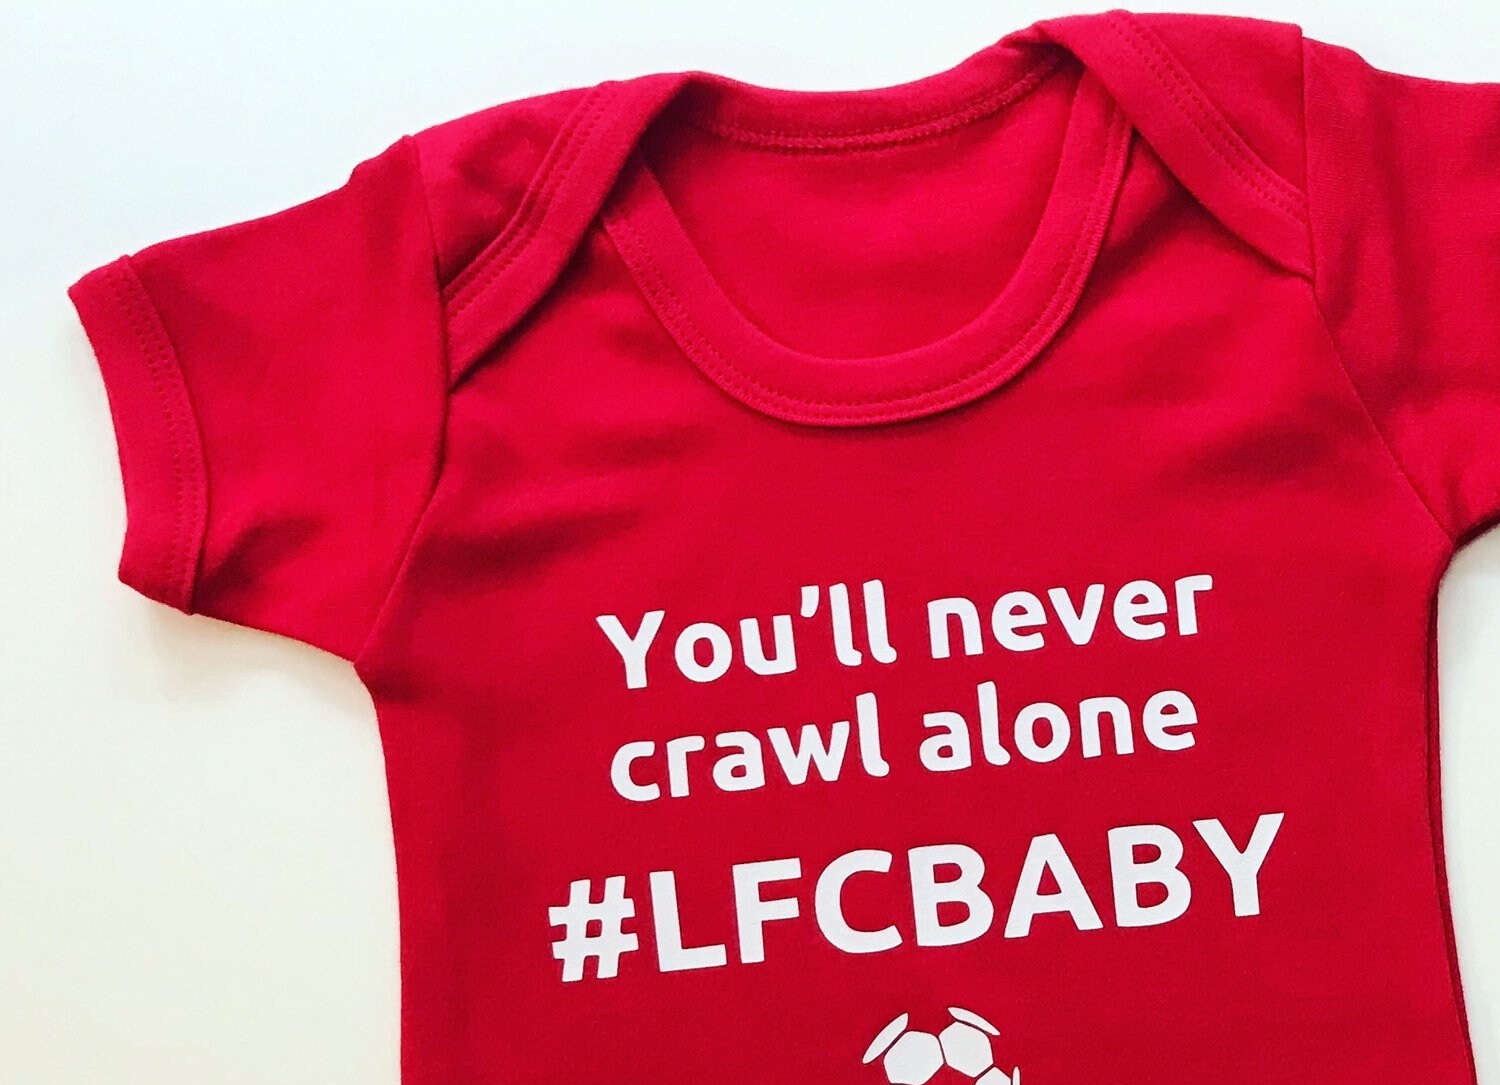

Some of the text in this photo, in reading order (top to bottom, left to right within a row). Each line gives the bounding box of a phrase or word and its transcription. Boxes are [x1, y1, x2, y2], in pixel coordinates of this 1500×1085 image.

[595, 574, 1213, 690] You'll never
[610, 680, 1198, 802] crawl alone
[548, 812, 1285, 983] #LFCBABY
